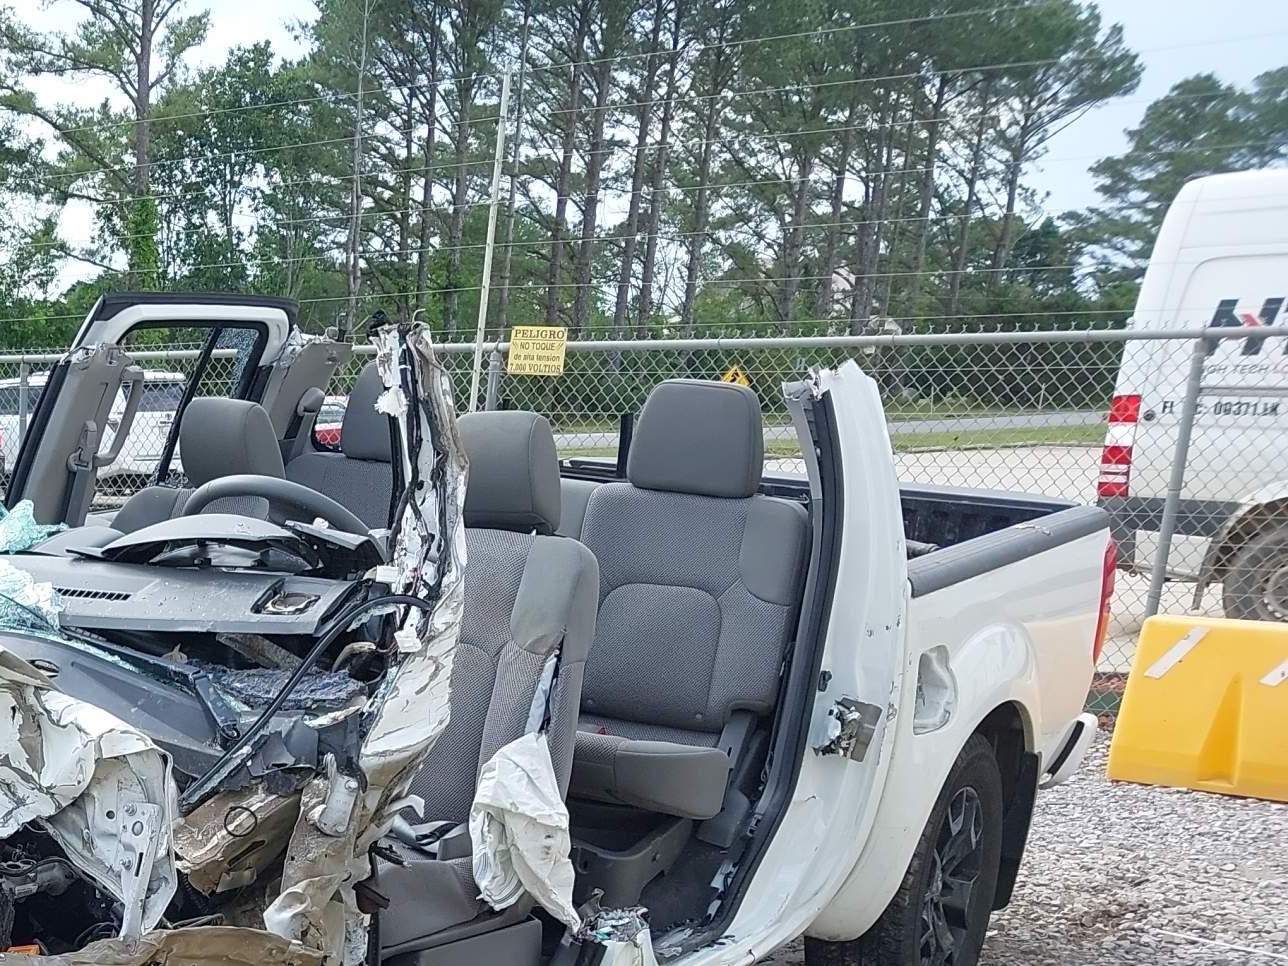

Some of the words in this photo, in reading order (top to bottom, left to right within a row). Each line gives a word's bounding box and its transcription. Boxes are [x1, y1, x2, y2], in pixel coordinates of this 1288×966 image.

[513, 329, 565, 339] PELIGRO
[519, 342, 530, 350] NO
[532, 342, 556, 351] TOQUE
[513, 353, 521, 361] de
[536, 354, 561, 362] tension
[528, 364, 561, 374] VOLTIOS
